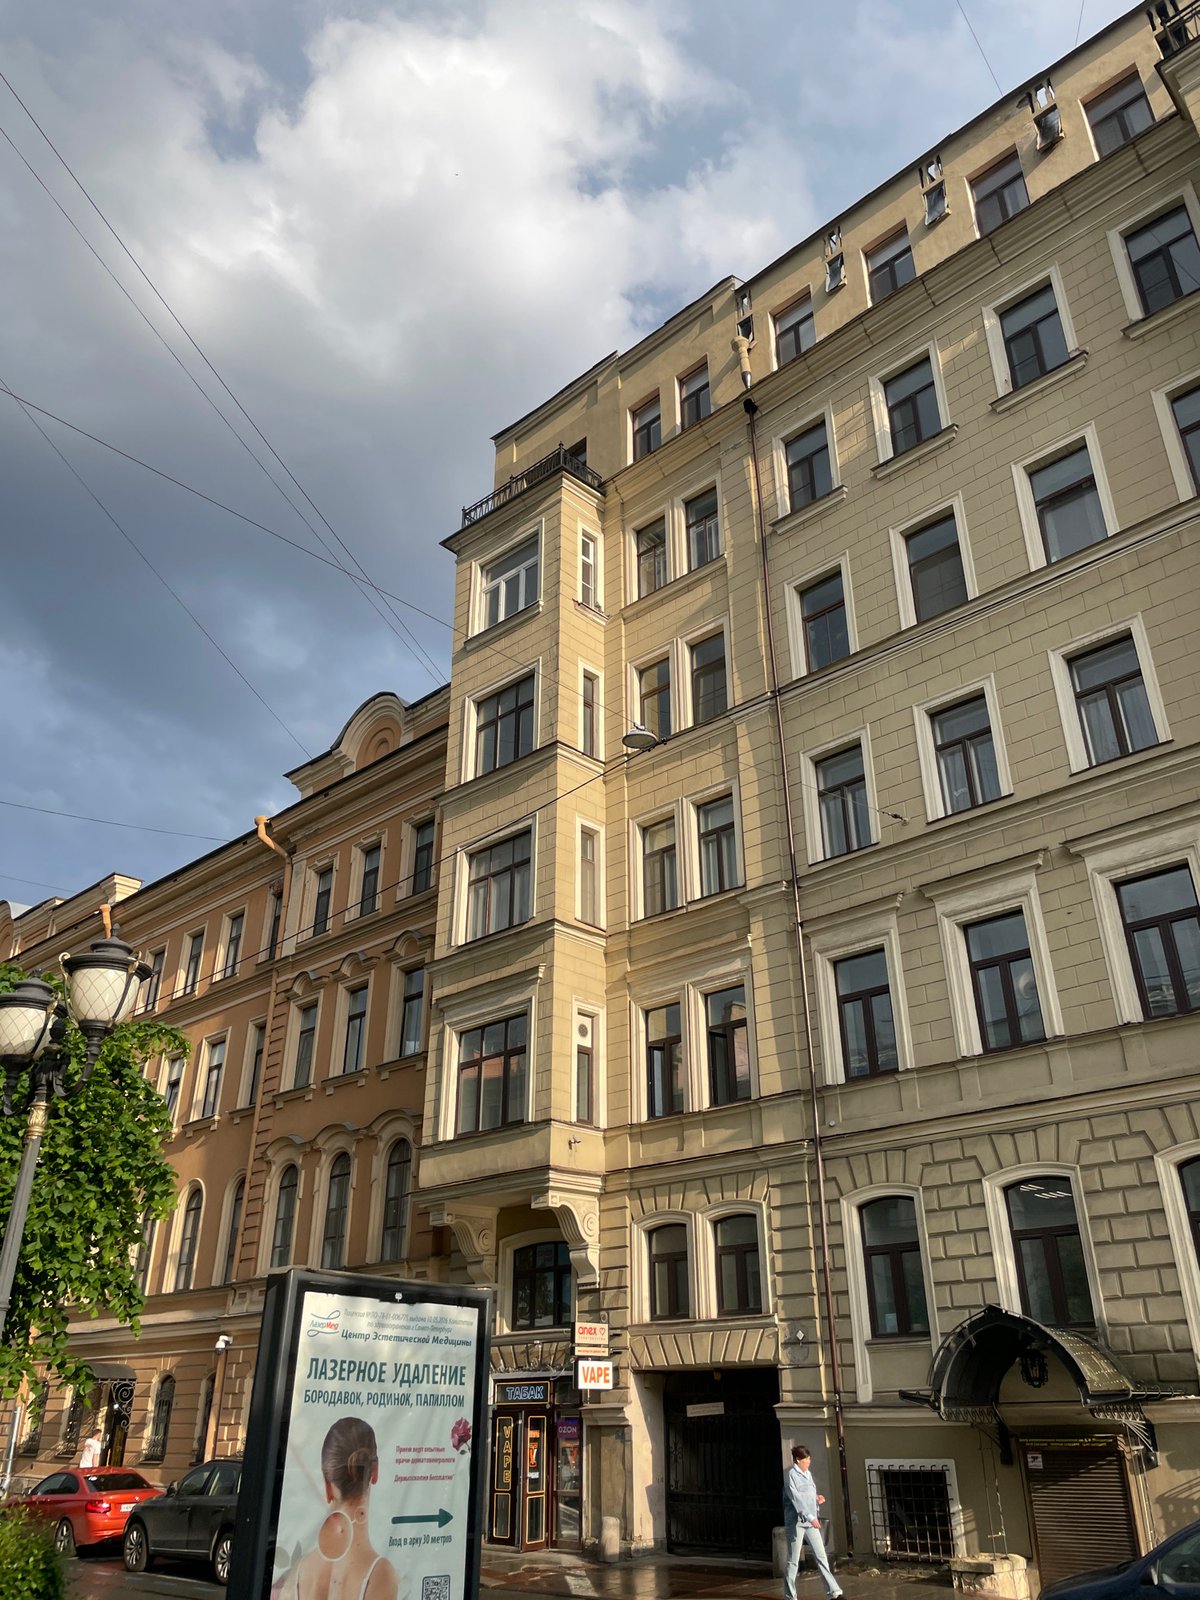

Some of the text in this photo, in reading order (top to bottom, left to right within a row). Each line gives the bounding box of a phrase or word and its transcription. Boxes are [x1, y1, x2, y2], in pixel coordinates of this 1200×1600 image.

[341, 1329, 472, 1347] Центр Эстетической Медицины
[578, 1326, 597, 1336] anex
[307, 1357, 466, 1388] ЛАЗЕРНОЕ УДАЛЕНИЕ
[582, 1366, 610, 1384] VAPE
[304, 1389, 465, 1408] БОРОДАВОК, РОДИНОК, ПАПИЛЛОМ
[506, 1386, 544, 1400] ТАБАК
[503, 1425, 512, 1484] VAPE
[389, 1534, 452, 1548] Вход в арку 30 метров
